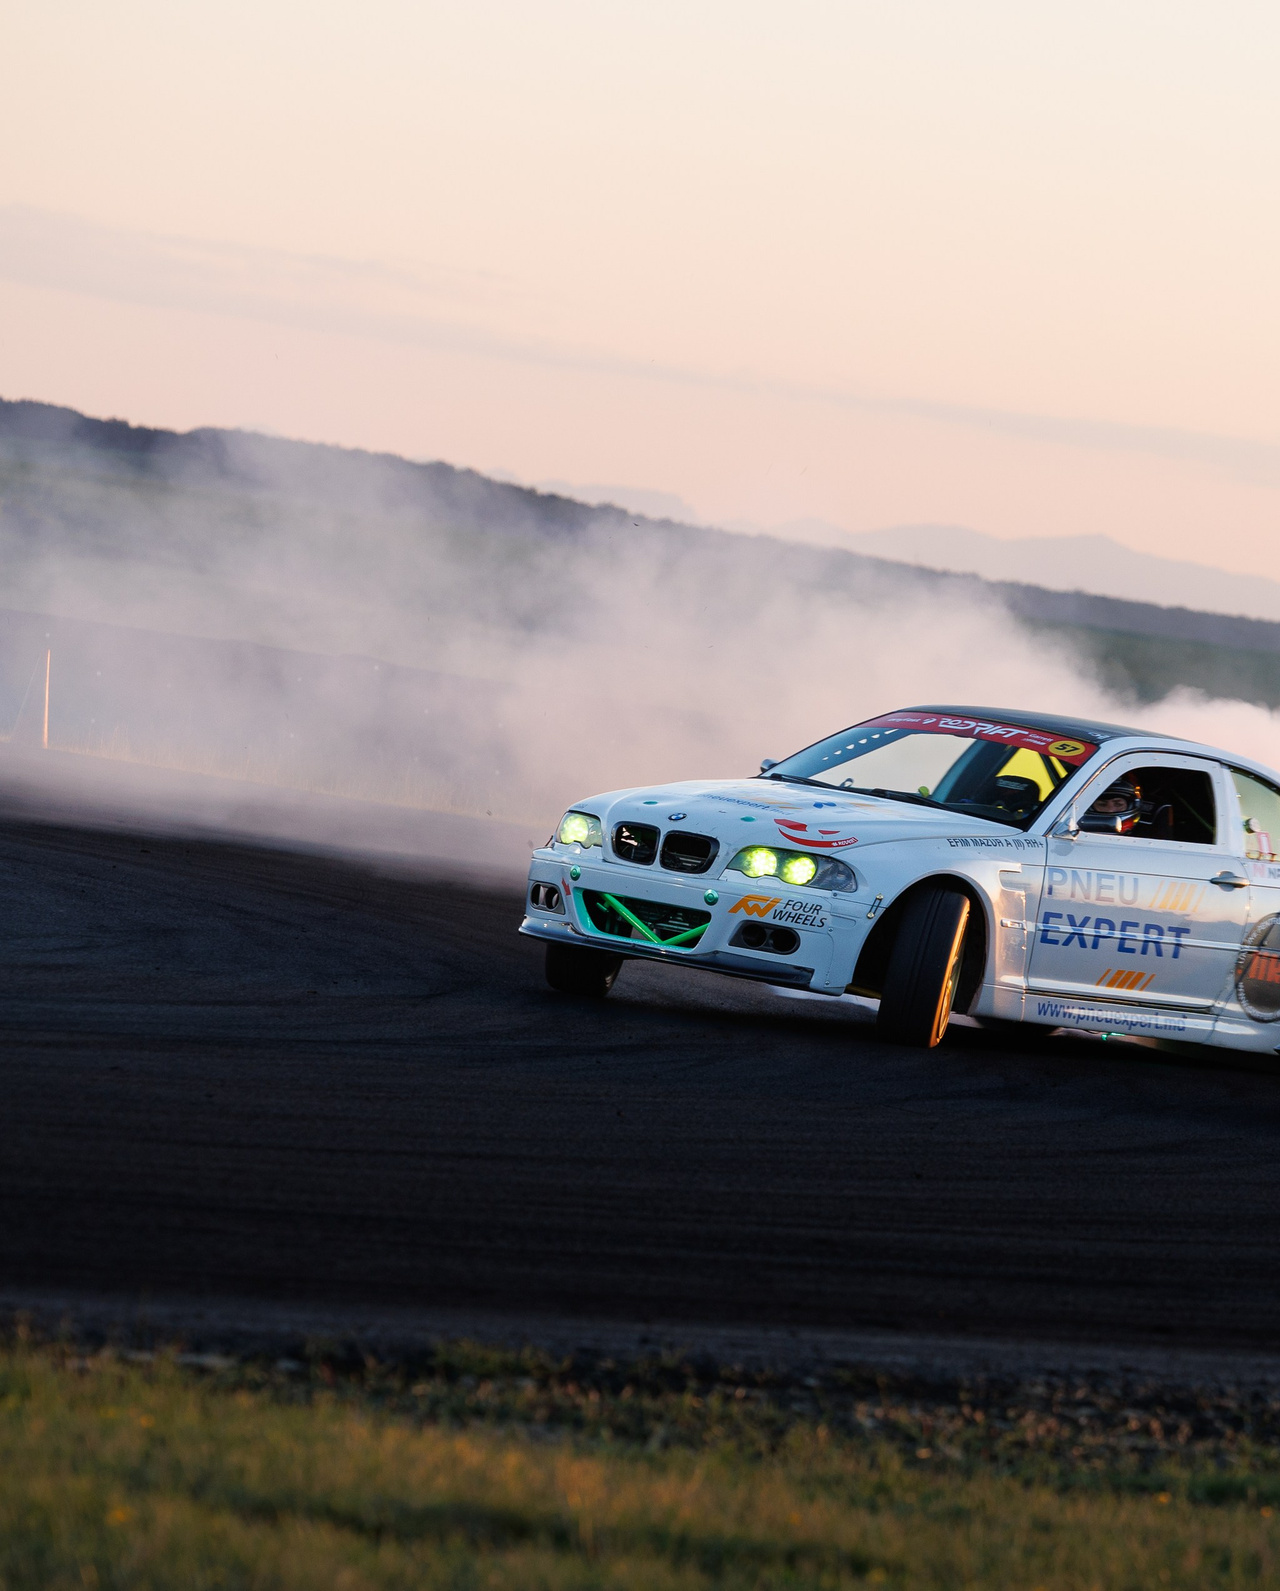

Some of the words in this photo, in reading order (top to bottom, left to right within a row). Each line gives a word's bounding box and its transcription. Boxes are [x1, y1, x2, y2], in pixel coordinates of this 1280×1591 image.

[1054, 743, 1080, 753] 57
[947, 838, 971, 847] EFIM
[970, 838, 1004, 848] MAZUR
[1006, 839, 1013, 847] A
[1047, 867, 1139, 905] PNEU
[783, 899, 822, 915] FOUR
[772, 909, 827, 928] WHEELS
[1040, 911, 1191, 959] EXPERT
